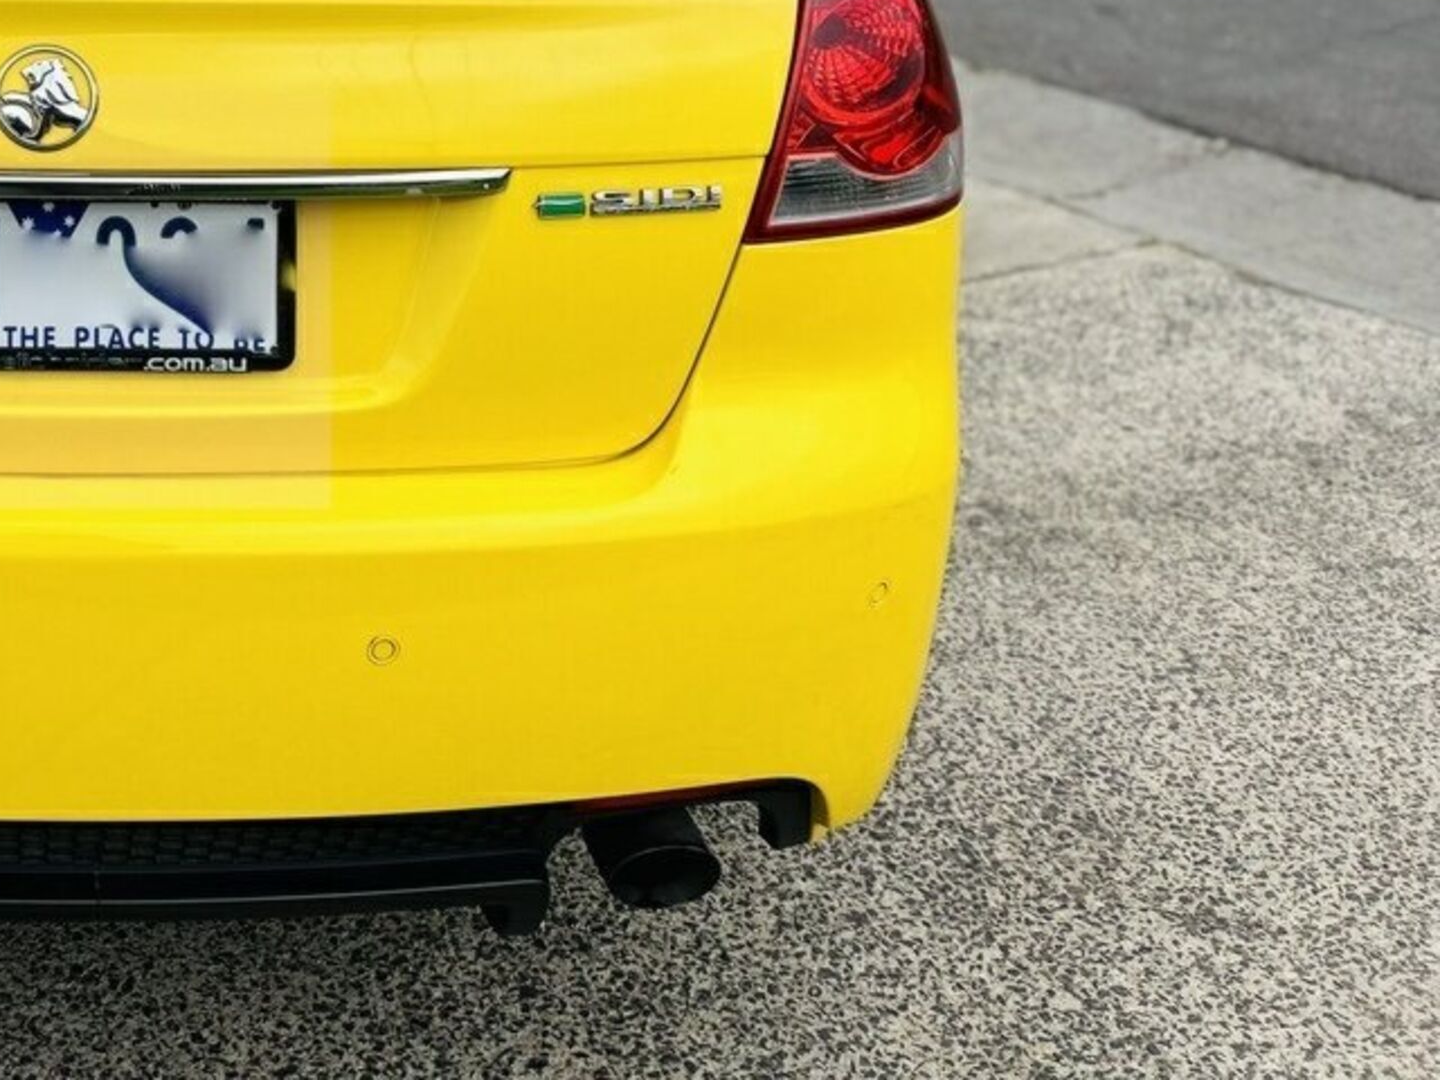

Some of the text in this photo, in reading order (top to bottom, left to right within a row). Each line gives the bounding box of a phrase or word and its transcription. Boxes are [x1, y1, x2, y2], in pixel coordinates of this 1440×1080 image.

[590, 186, 722, 216] SIDI
[3, 326, 56, 348] THE
[74, 324, 160, 349] PLACE
[143, 356, 247, 372] .com.au
